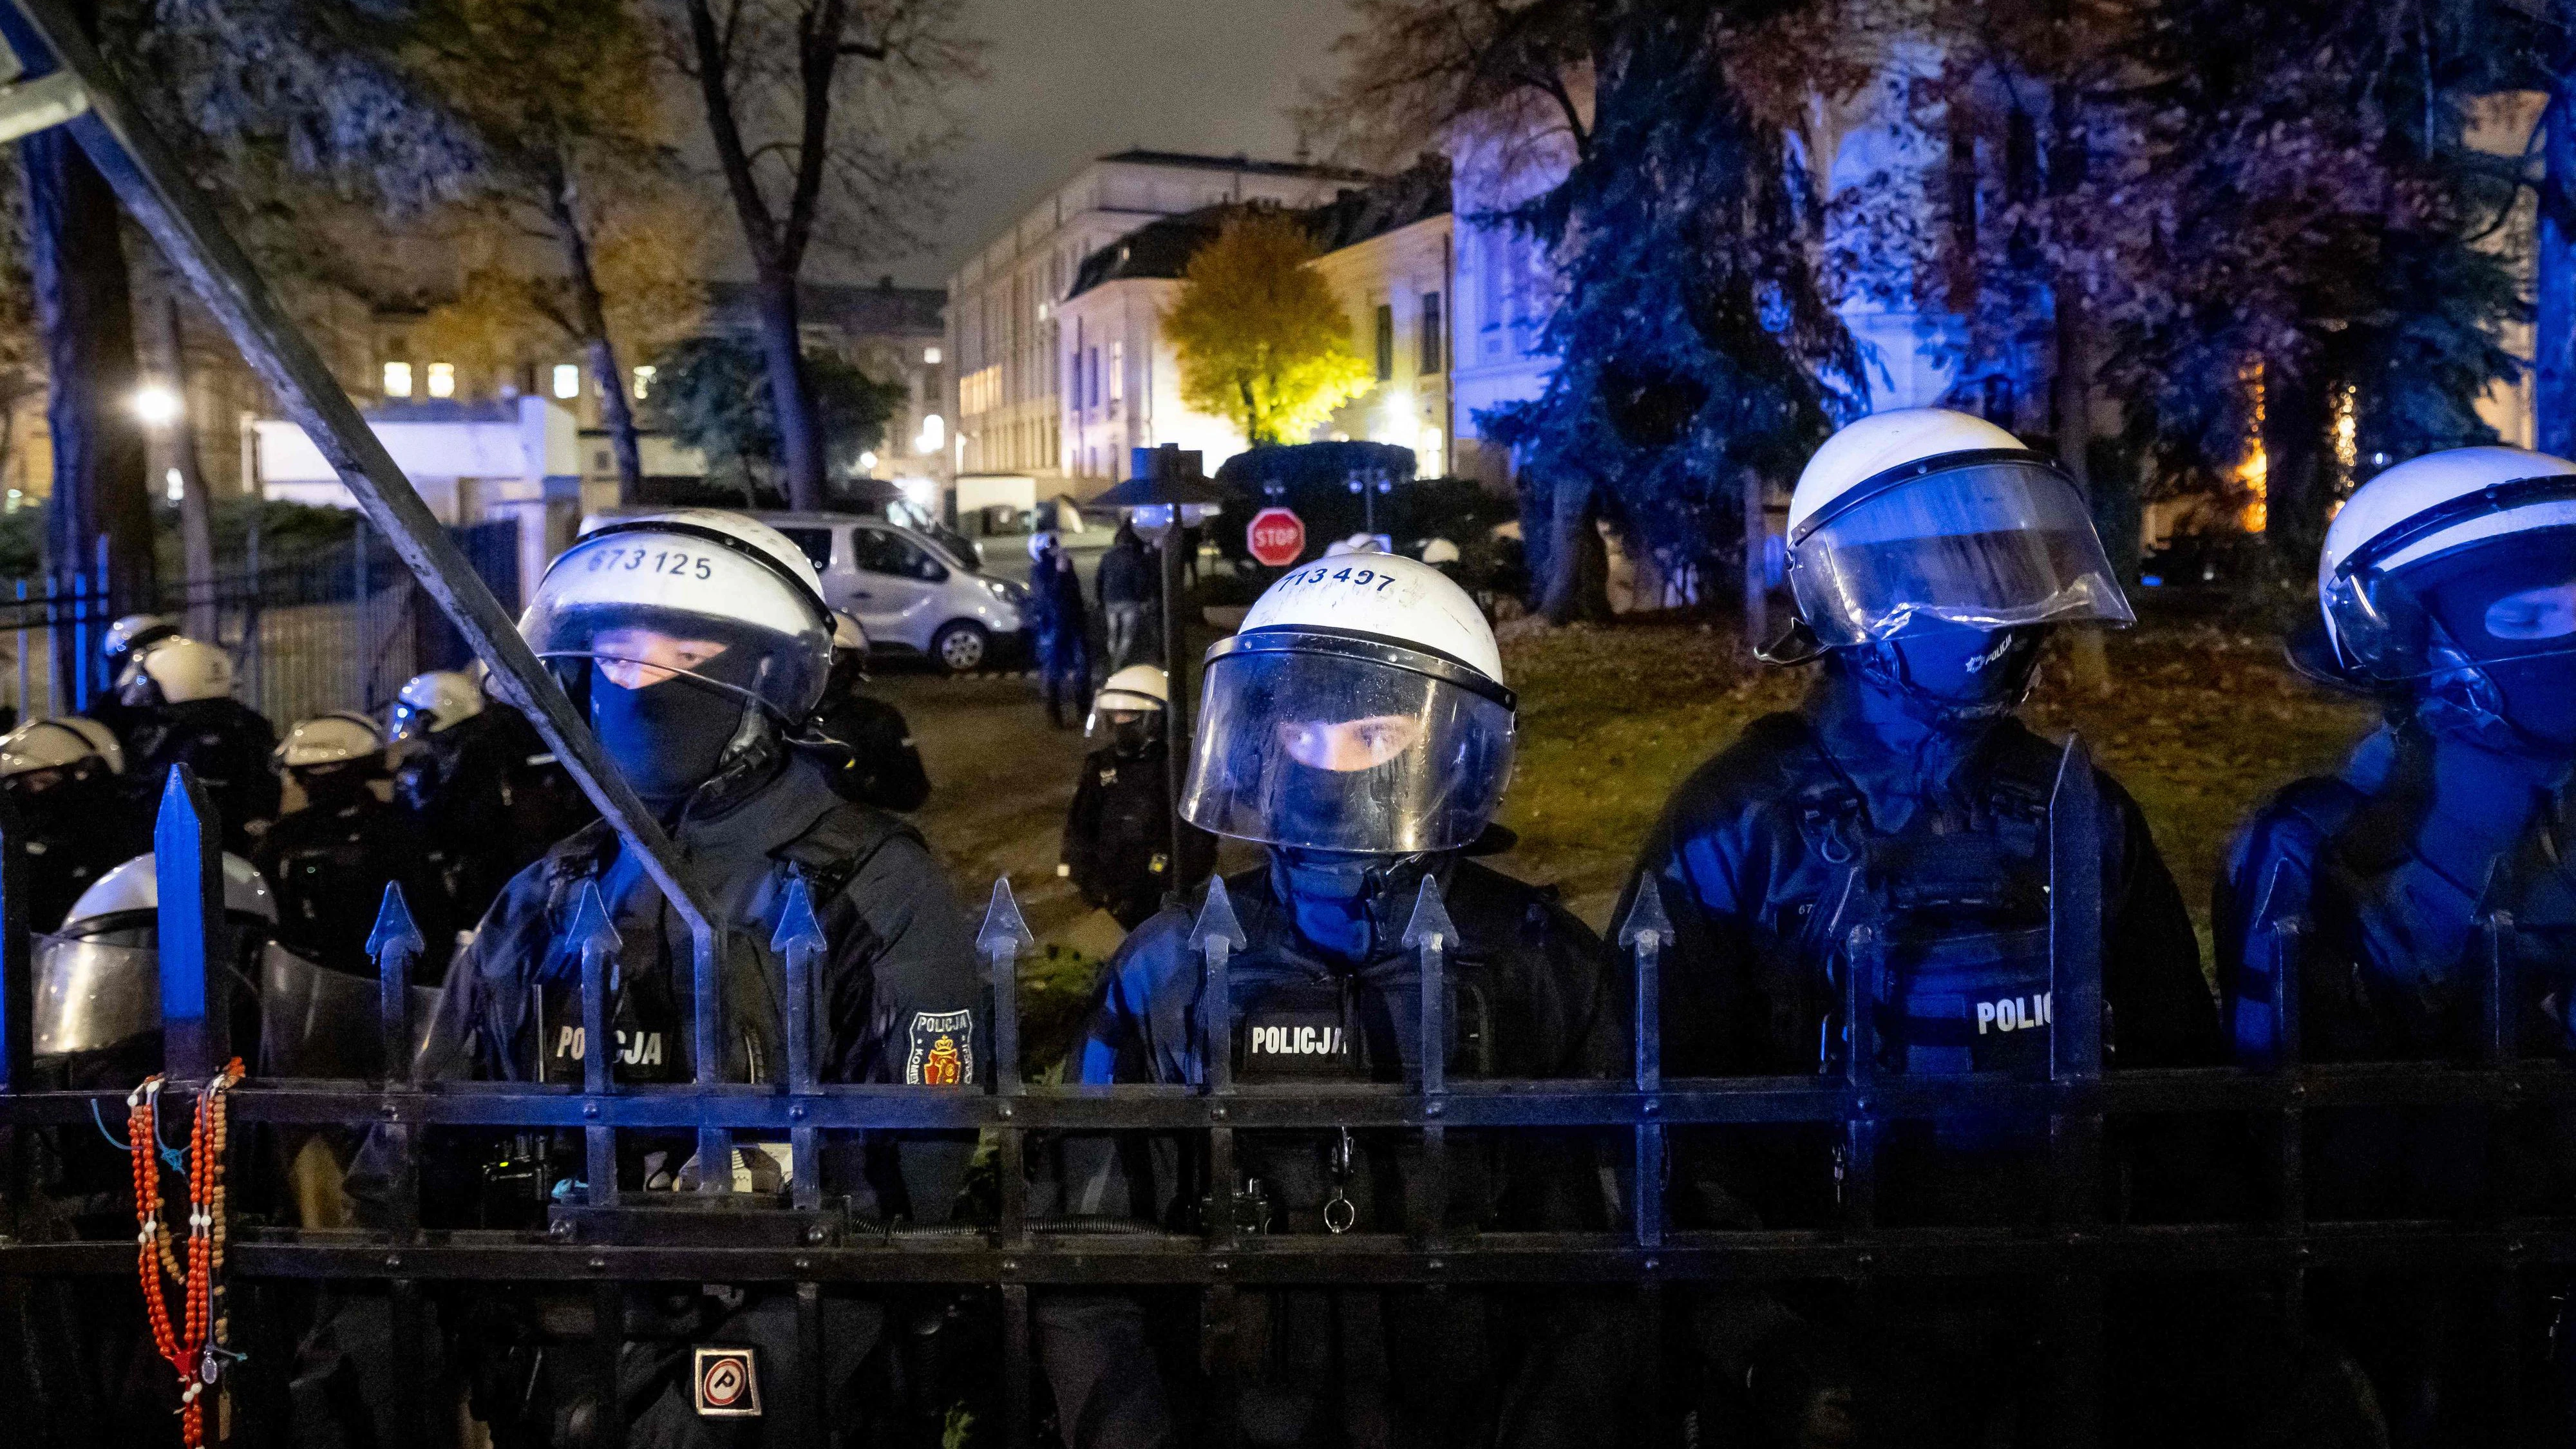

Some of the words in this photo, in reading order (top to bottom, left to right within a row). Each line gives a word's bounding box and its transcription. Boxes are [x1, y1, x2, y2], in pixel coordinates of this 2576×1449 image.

[1255, 527, 1298, 547] STOP
[588, 549, 646, 571] 673
[656, 551, 711, 580] 125
[1277, 567, 1328, 592] 713
[1333, 567, 1396, 592] 497
[1985, 633, 2012, 666] POLICJA
[917, 1015, 967, 1032] POLICJA
[556, 1025, 662, 1065] POCJA
